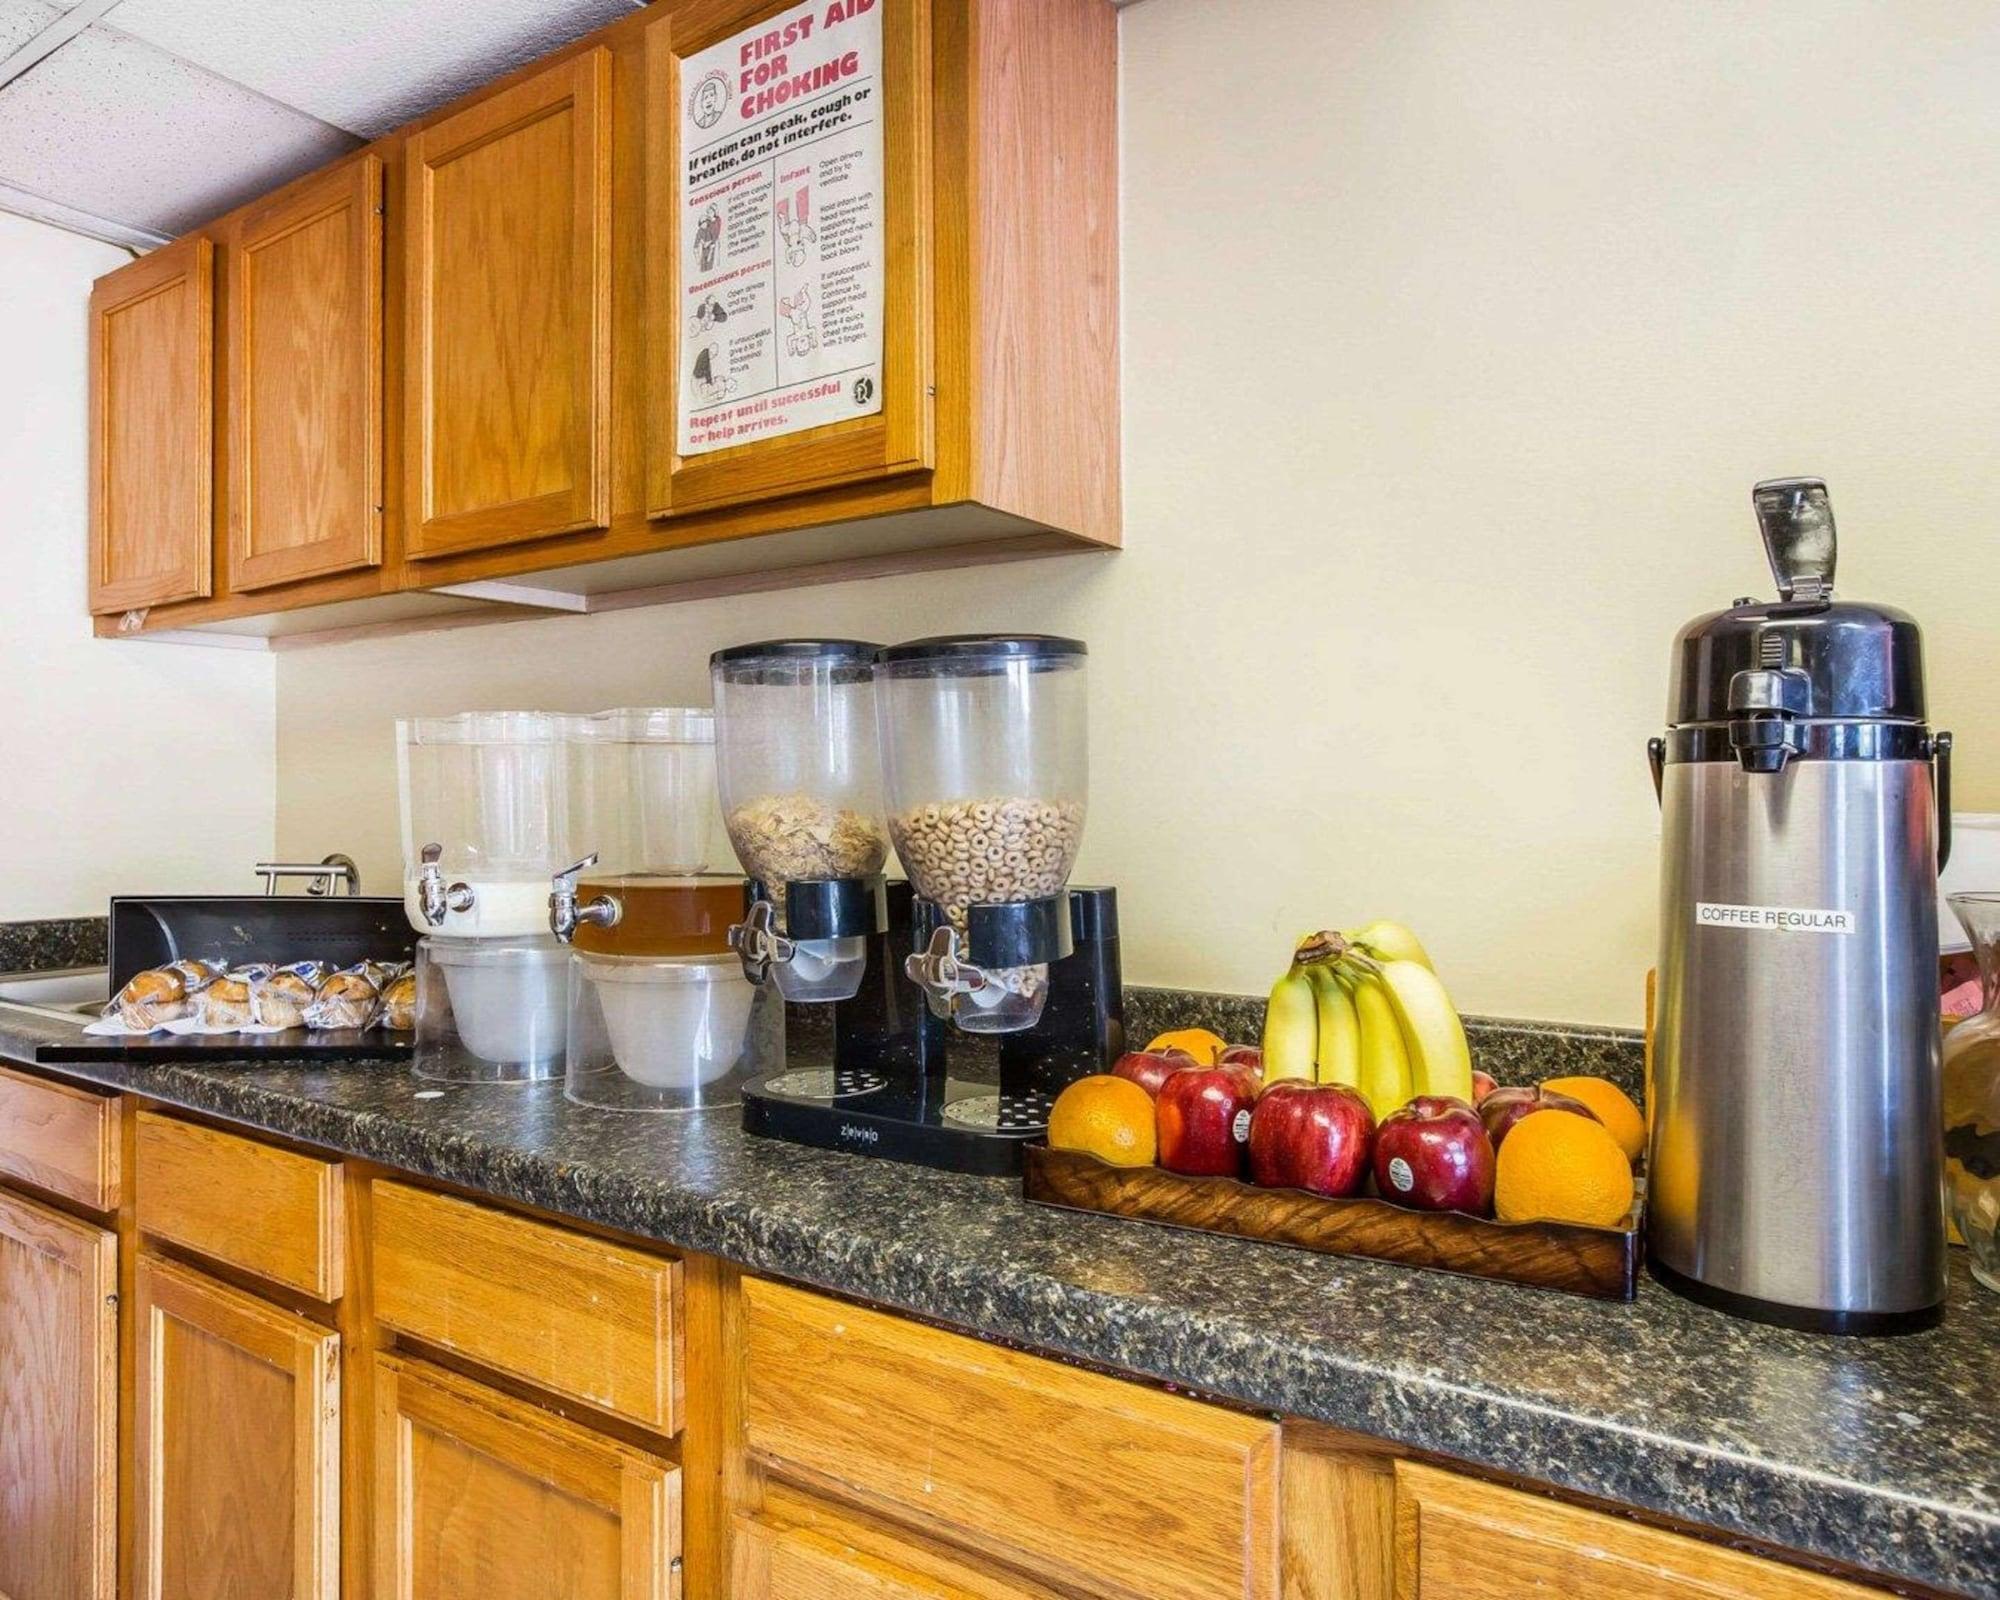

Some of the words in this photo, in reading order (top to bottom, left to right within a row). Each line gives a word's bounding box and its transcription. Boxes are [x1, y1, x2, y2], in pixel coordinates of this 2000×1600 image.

[741, 15, 814, 67] FIRST
[824, 0, 875, 29] AID
[740, 54, 788, 93] FOR
[740, 52, 858, 119] CHOKING
[688, 157, 700, 171] If
[701, 143, 738, 165] victim
[740, 132, 762, 148] can
[765, 113, 807, 138] speak,
[811, 95, 851, 118] cough
[855, 89, 871, 101] or
[689, 158, 740, 185] breathe,
[741, 148, 755, 162] do
[758, 140, 779, 156] not
[783, 114, 852, 144] interfere.
[689, 183, 730, 206] Conscious
[732, 171, 761, 191] person
[780, 166, 811, 184] Infant
[689, 270, 739, 294] Unconscious
[740, 260, 771, 276] person
[690, 409, 732, 428] Repeat
[737, 399, 768, 418] until
[771, 380, 841, 408] successful
[690, 431, 704, 444] or
[708, 423, 734, 443] help
[737, 414, 788, 435] arrives.
[1702, 908, 1759, 923] COFFEE
[1765, 912, 1846, 928] REGULAR
